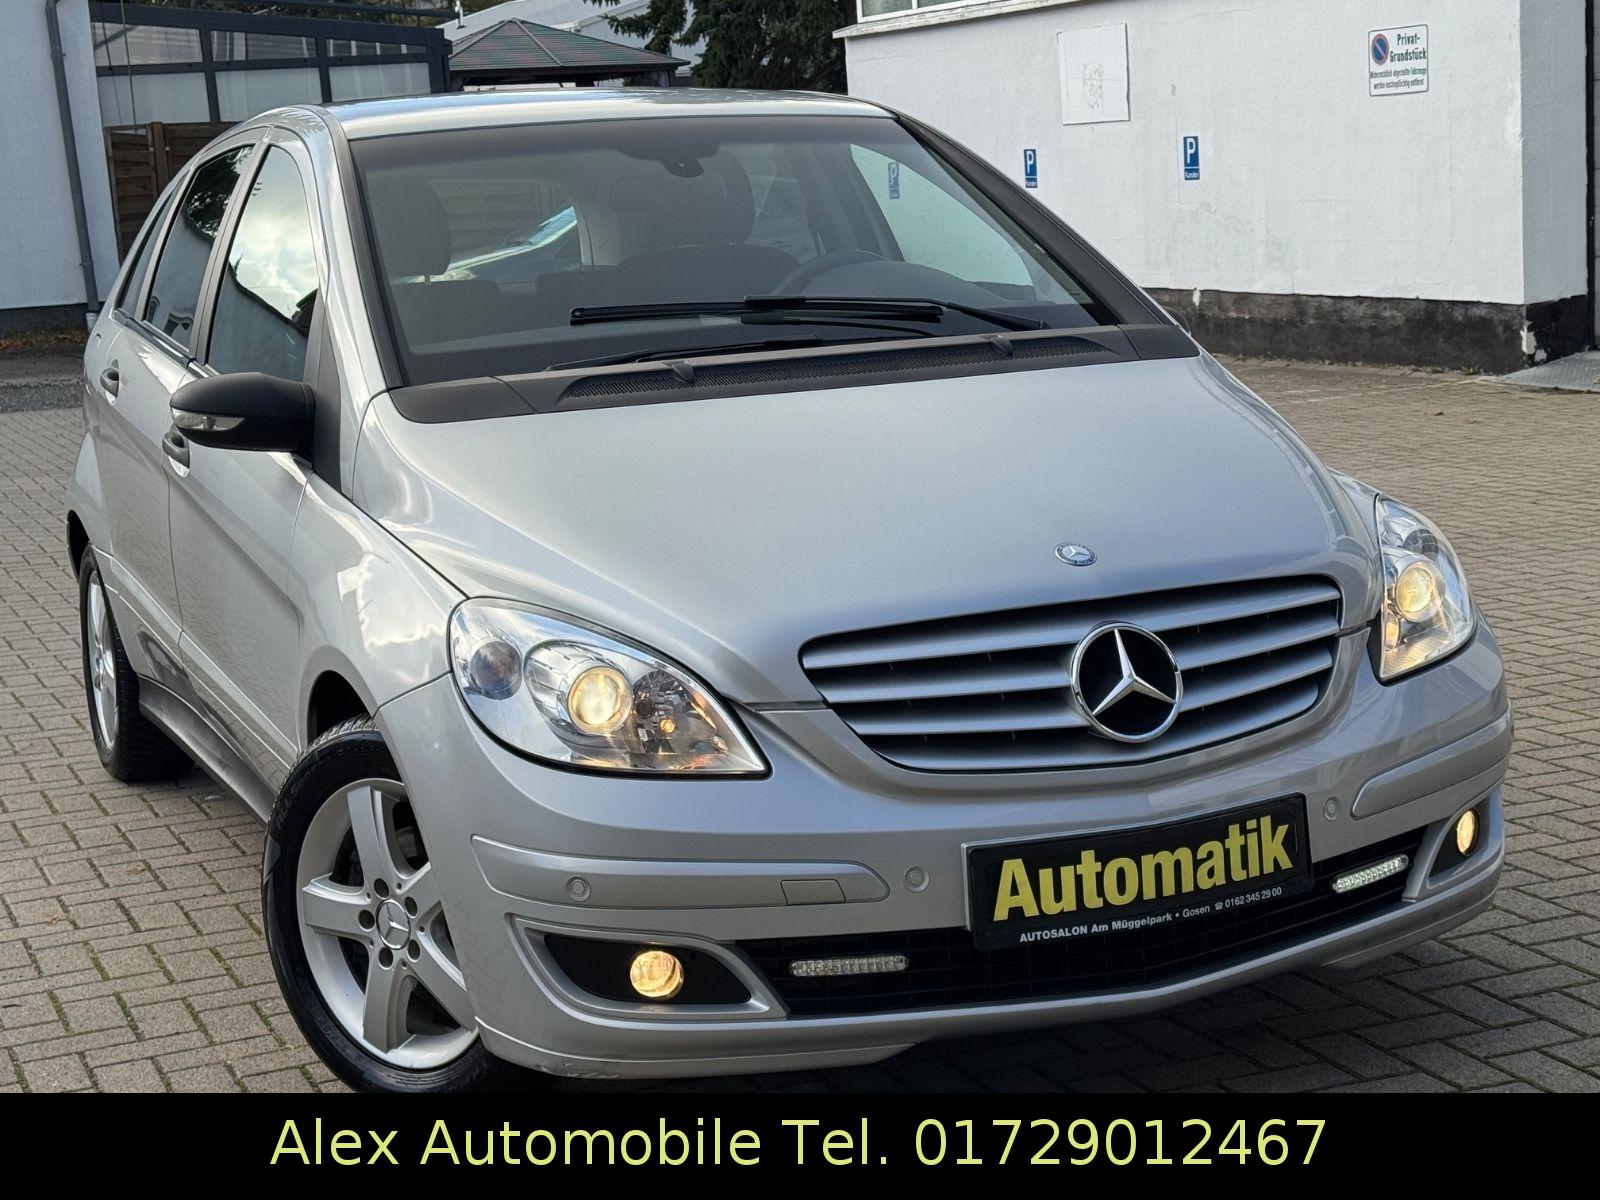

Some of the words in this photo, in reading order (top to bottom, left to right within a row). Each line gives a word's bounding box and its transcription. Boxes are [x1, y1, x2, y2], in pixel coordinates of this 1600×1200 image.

[1397, 33, 1421, 46] Privat-
[1390, 47, 1427, 63] Grundstück
[1026, 150, 1034, 174] P
[1186, 137, 1196, 164] P
[993, 815, 1294, 922] Automatik
[1020, 925, 1088, 943] AUTOSALON
[1091, 923, 1108, 934] Am
[1112, 912, 1172, 930] Müggelpark
[1182, 905, 1210, 918] Gosen
[1225, 895, 1245, 908] 0162
[1245, 893, 1261, 904] 345
[1261, 889, 1271, 900] 29
[1271, 886, 1282, 897] 00
